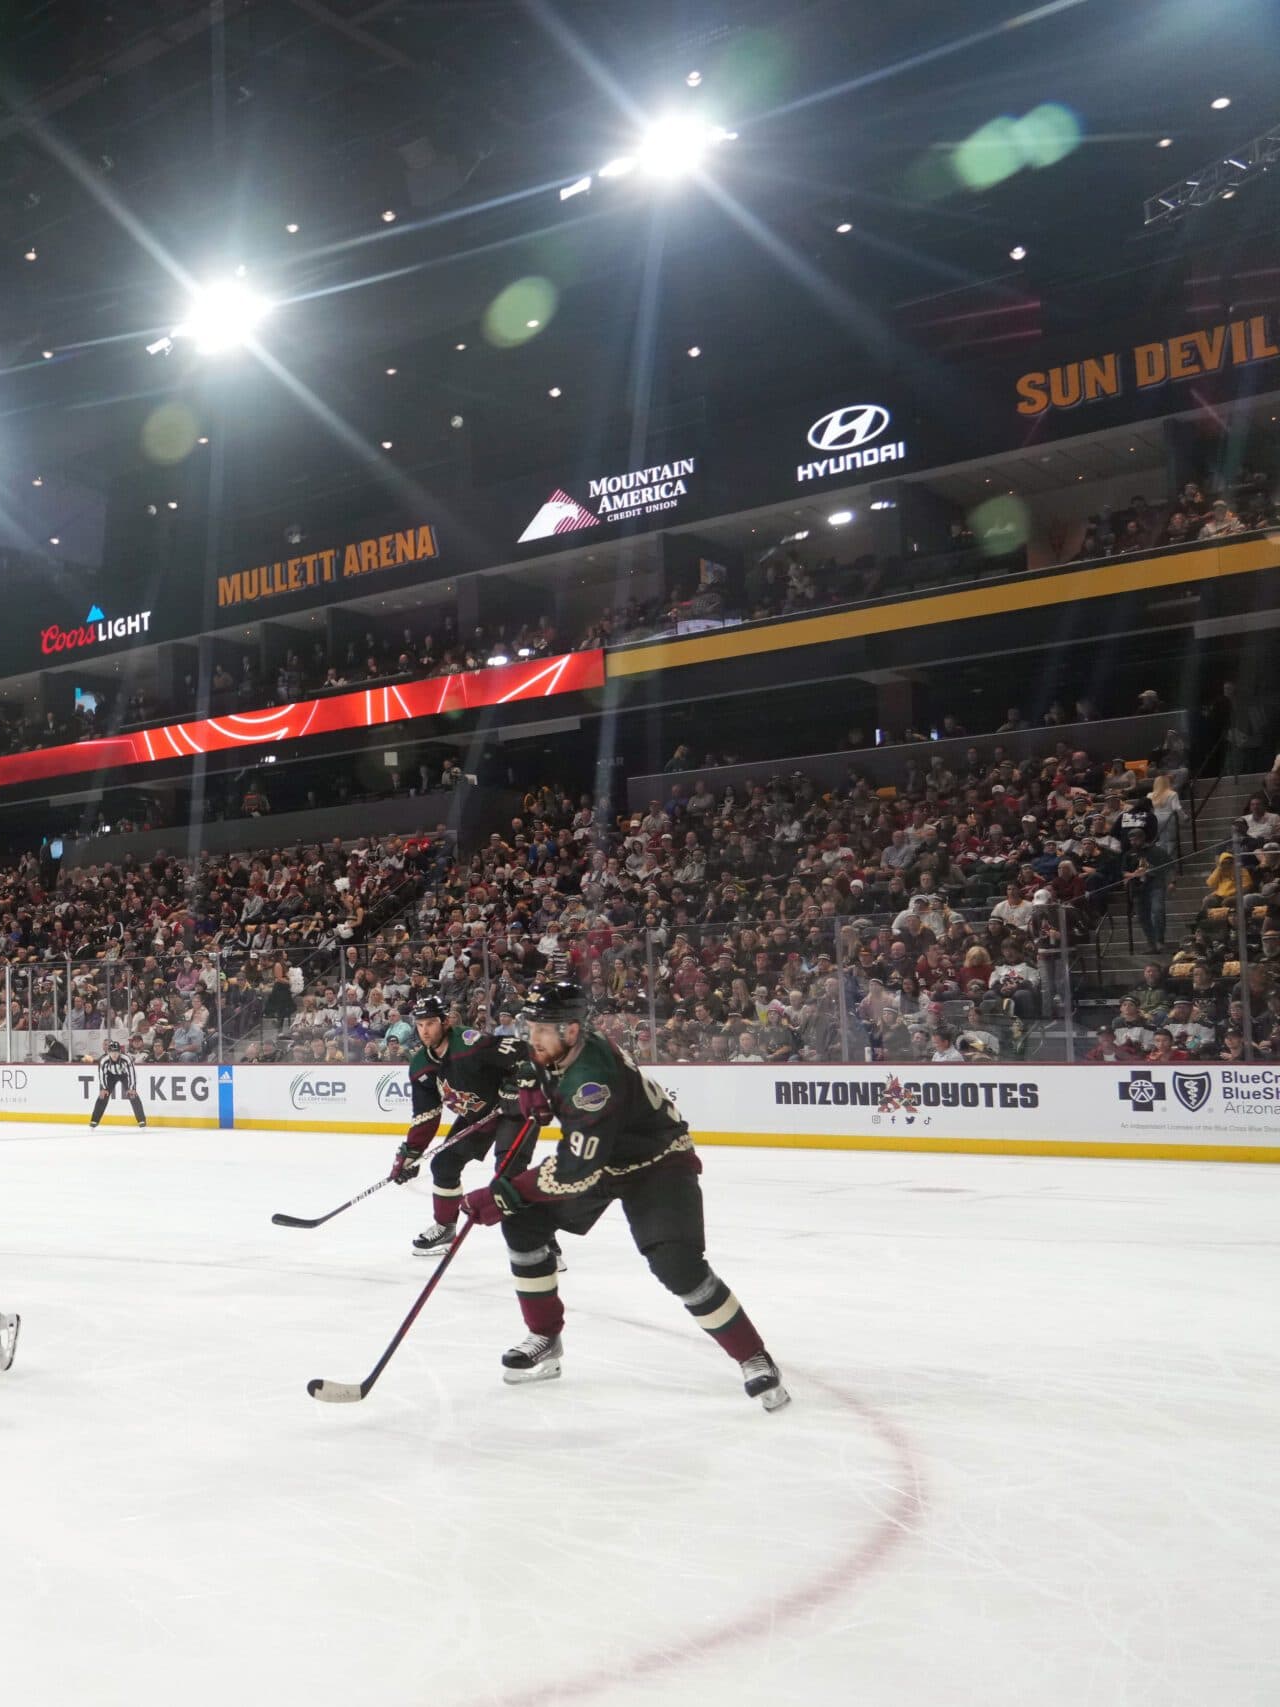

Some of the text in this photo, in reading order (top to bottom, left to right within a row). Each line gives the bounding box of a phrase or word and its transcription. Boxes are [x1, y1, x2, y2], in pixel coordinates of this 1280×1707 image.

[1016, 316, 1278, 416] SUN DEVIL
[797, 441, 905, 482] HYUNDAI
[588, 457, 695, 498] MOUNTAIN
[597, 479, 687, 515] AMERICA
[607, 499, 678, 522] CREDIT UNION
[217, 524, 437, 608] MULLETT ARENA
[40, 610, 152, 655] Coors LIGHT
[150, 1076, 210, 1101] KEG
[299, 1081, 346, 1097] ACP
[385, 1082, 412, 1098] AC
[775, 1081, 1039, 1109] ARIZONA COYOTES
[1224, 1101, 1280, 1115] Arizona
[569, 1131, 600, 1160] 90
